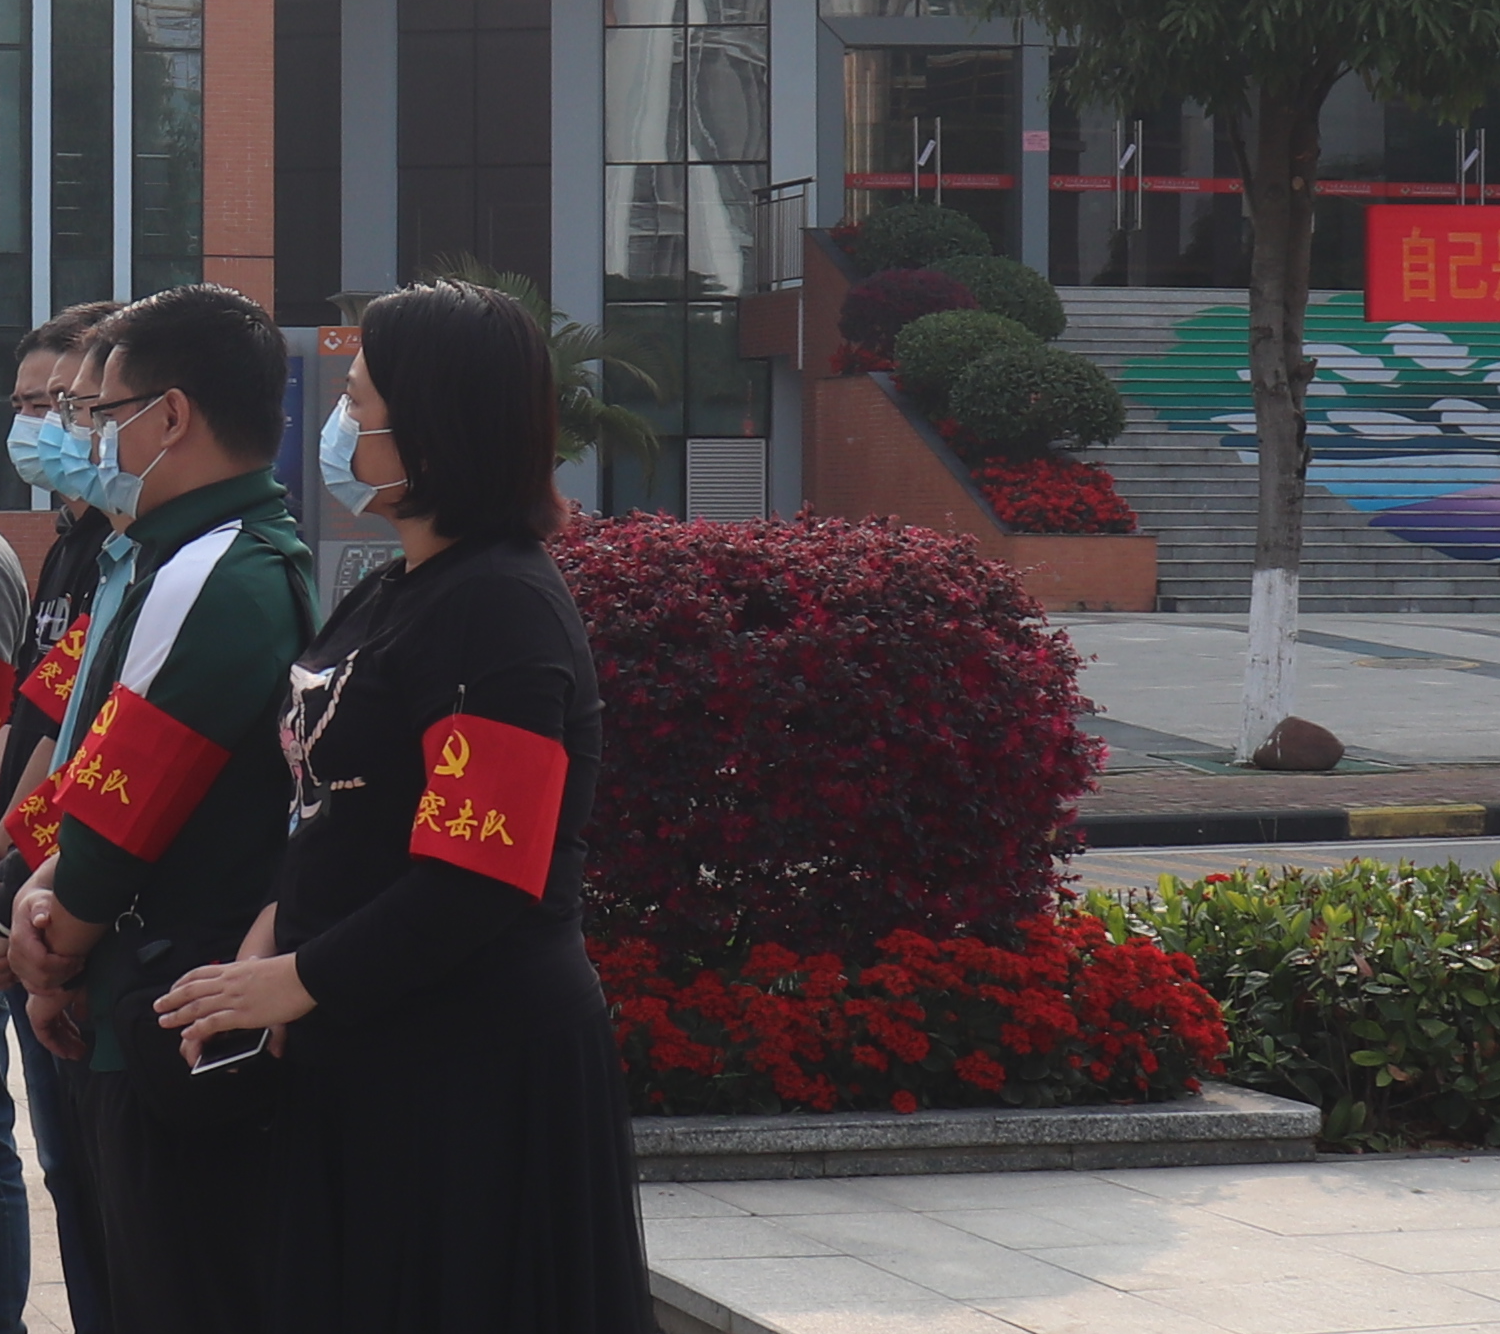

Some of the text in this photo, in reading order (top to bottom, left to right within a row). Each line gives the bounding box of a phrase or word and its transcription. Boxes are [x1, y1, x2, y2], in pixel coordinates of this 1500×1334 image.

[37, 661, 77, 701] 突击
[416, 790, 514, 846] 突击队
